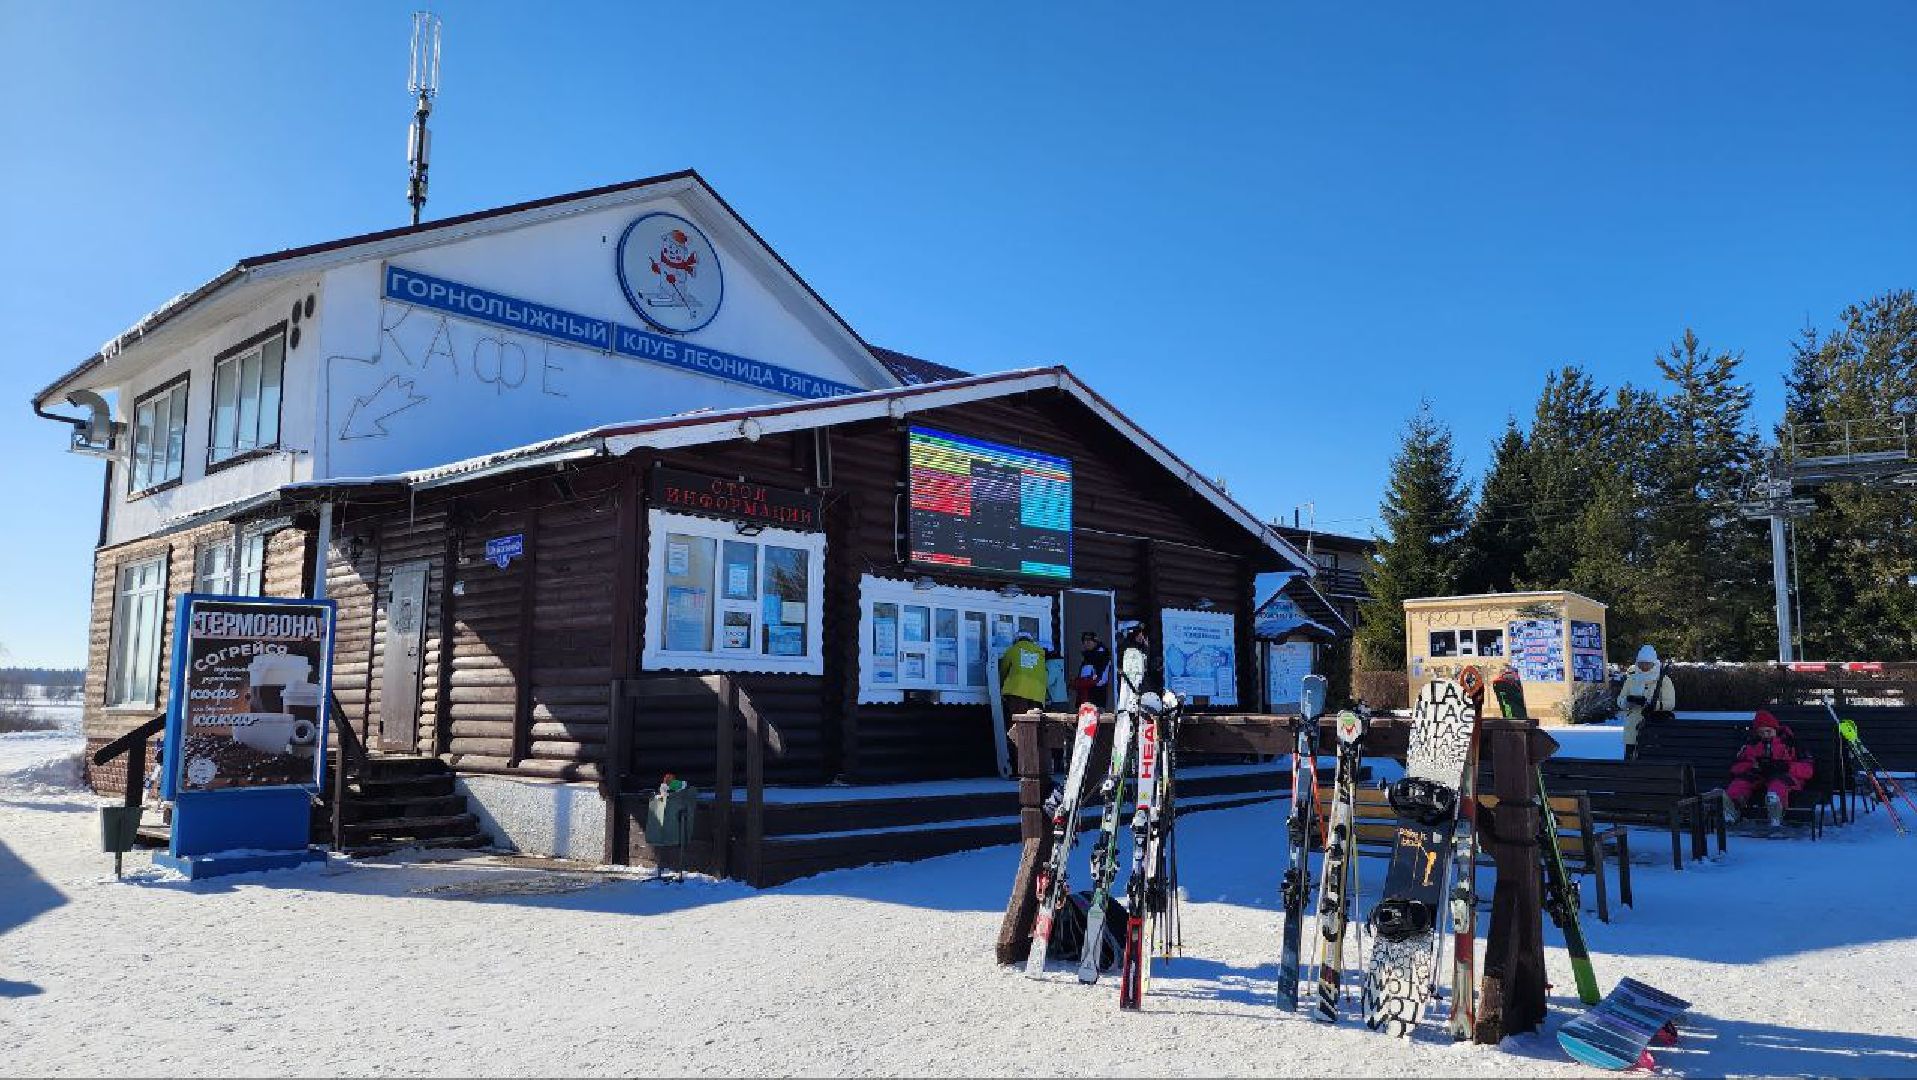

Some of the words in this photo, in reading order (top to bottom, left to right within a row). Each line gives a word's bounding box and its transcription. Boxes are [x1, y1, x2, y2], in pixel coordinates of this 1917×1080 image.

[391, 273, 608, 342] ГОРНОЛЫЖНЫЙ
[379, 303, 568, 397] КАФЕ
[623, 331, 677, 361] КЛУБ
[681, 348, 773, 385] ЛЕОНИДА
[711, 479, 767, 502] СТОЛ
[199, 611, 319, 638] ТЕРМОЗОНА
[195, 641, 288, 671] СОГРЕЙСЯ
